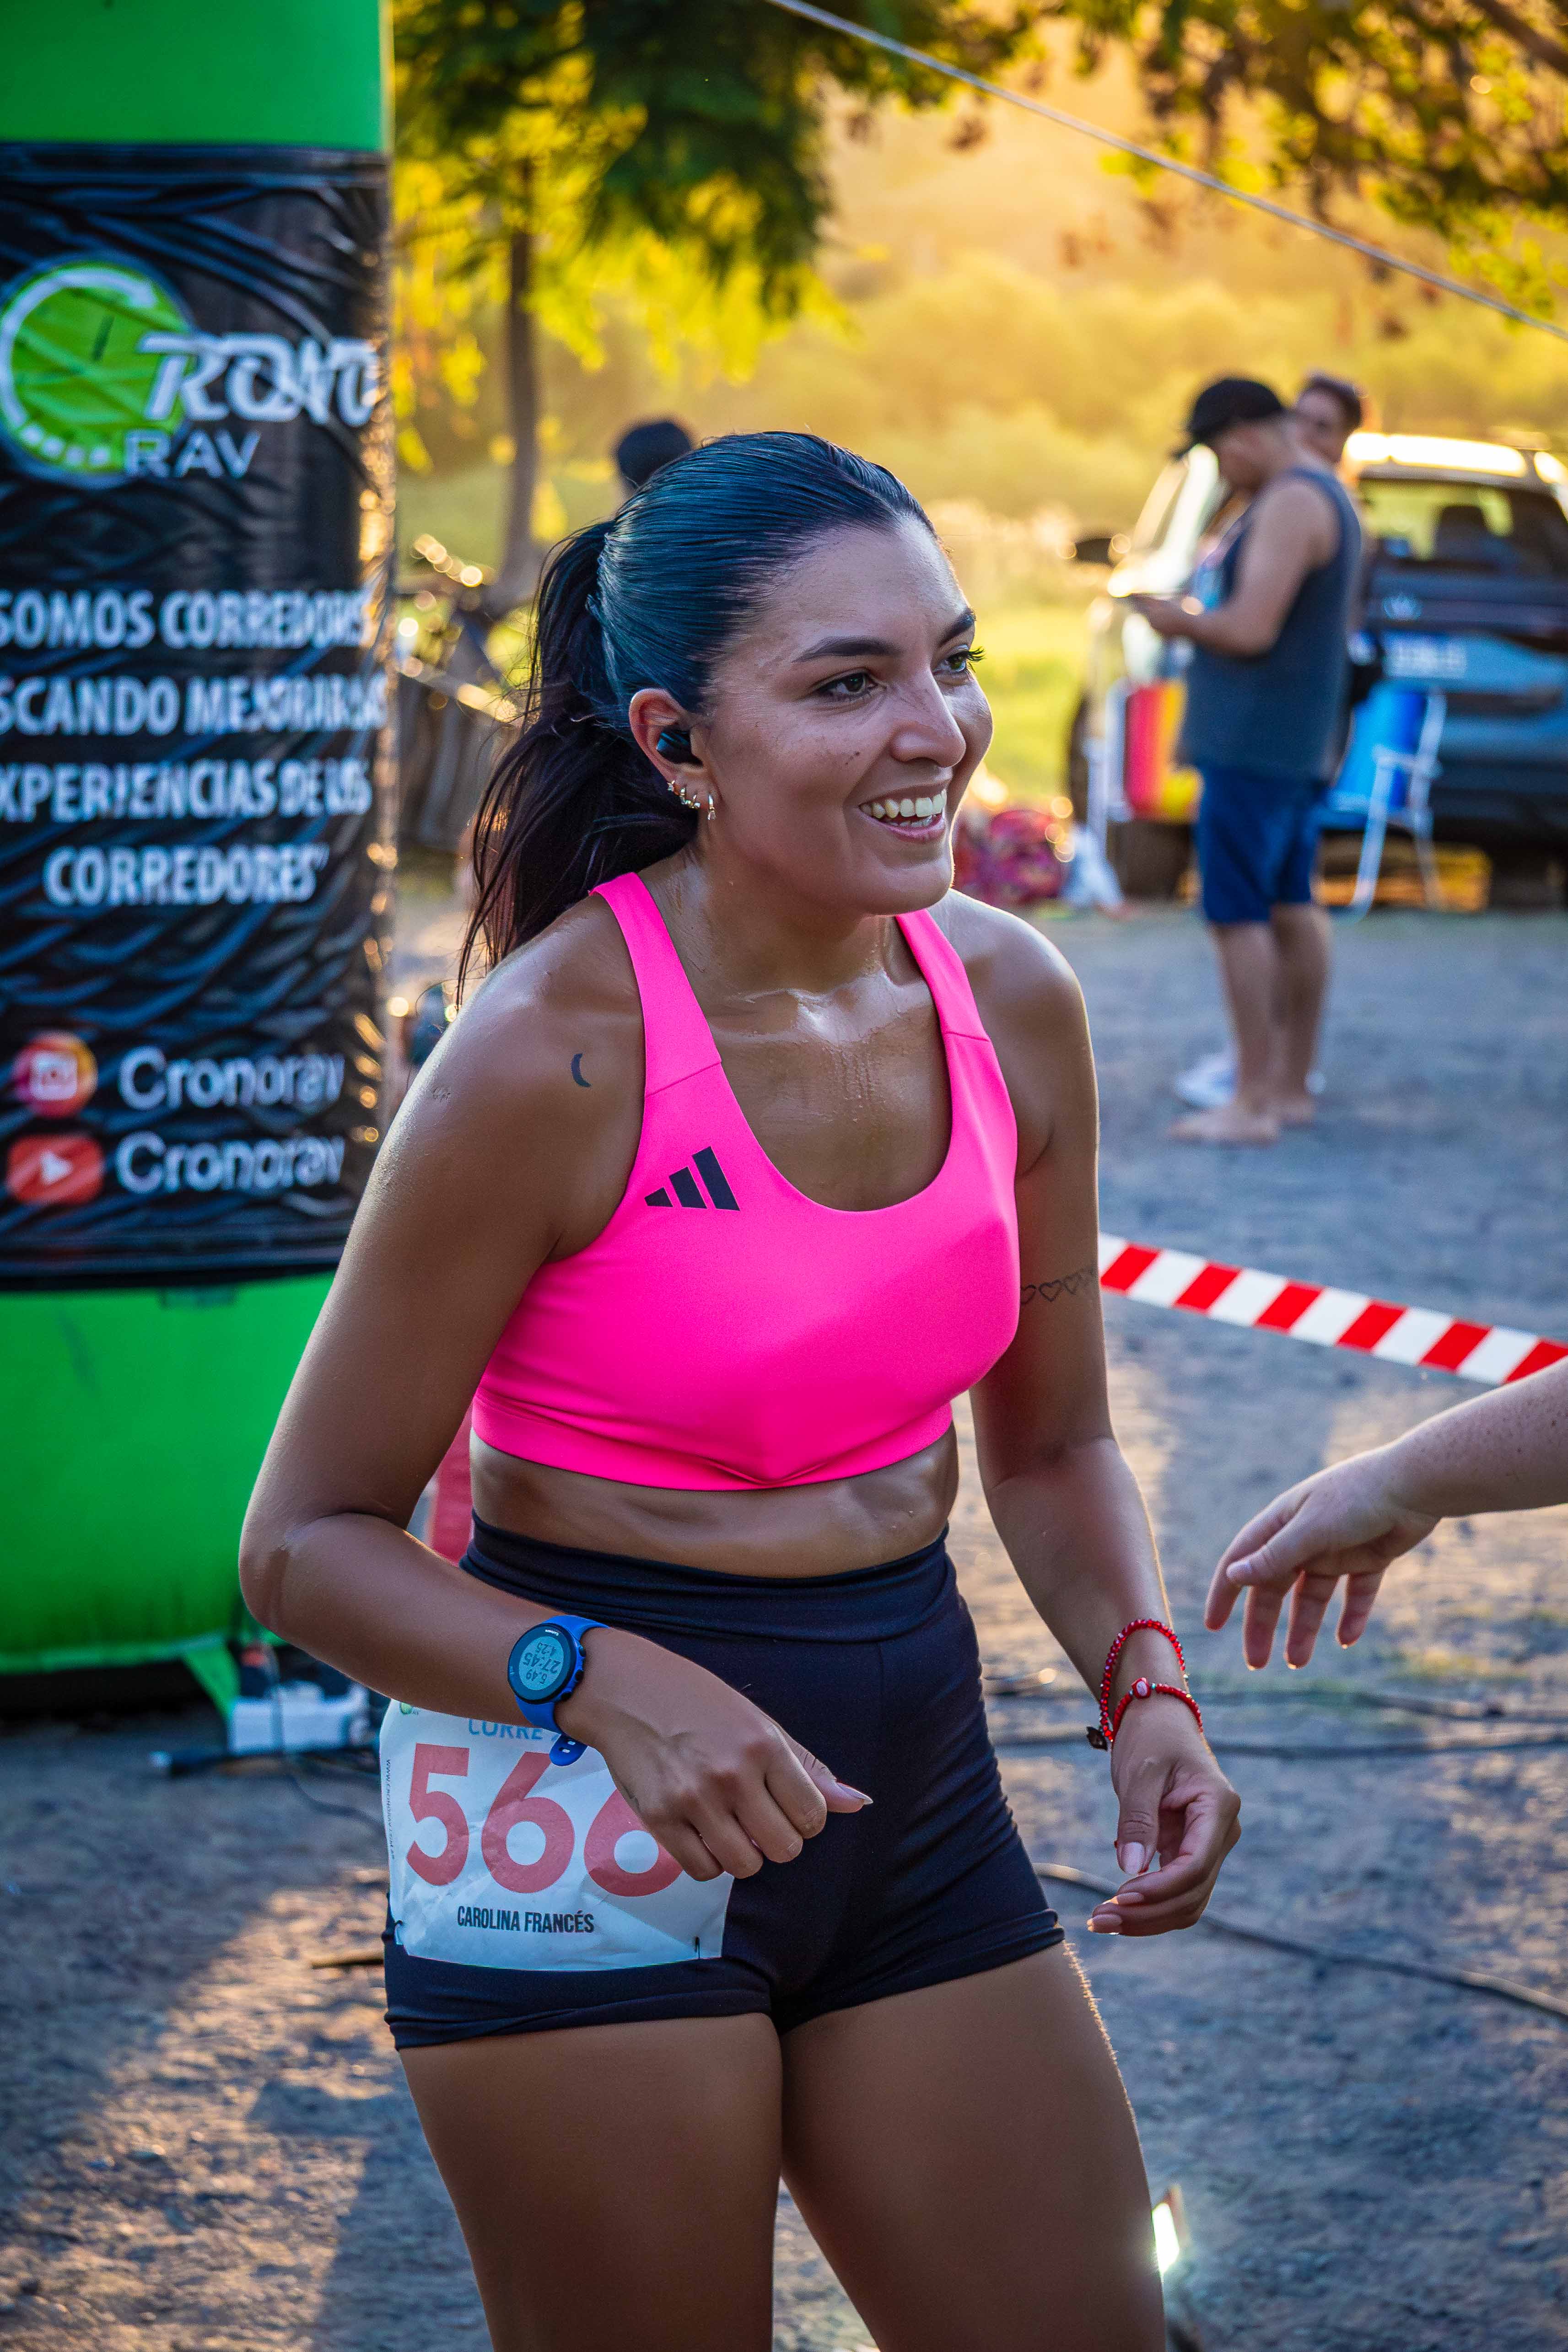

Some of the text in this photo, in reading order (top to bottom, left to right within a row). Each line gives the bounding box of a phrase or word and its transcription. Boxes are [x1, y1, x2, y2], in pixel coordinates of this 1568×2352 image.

[124, 428, 261, 479] RAV
[406, 1742, 686, 1897] 566
[457, 1905, 594, 1934] CAROLINA FRANCÉS
